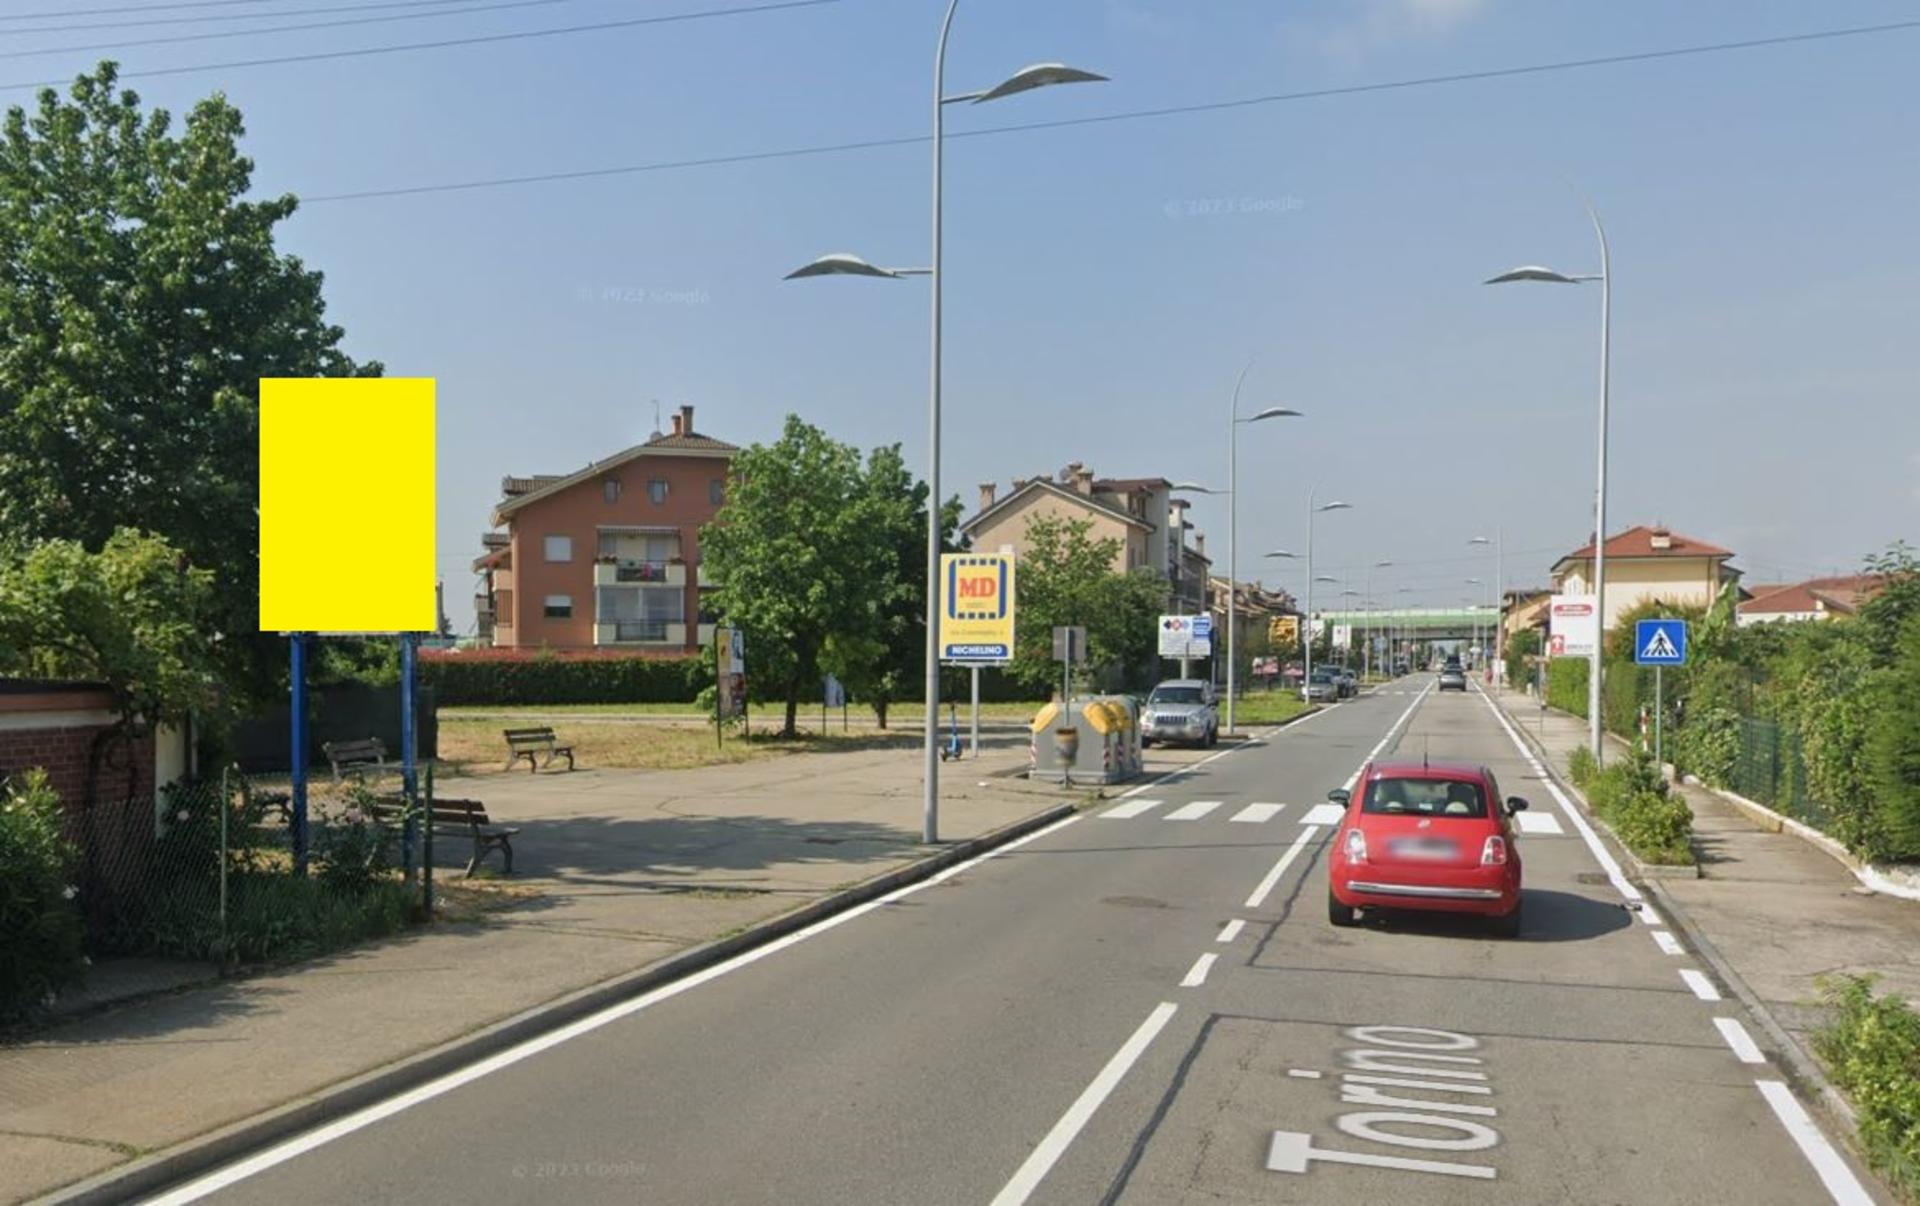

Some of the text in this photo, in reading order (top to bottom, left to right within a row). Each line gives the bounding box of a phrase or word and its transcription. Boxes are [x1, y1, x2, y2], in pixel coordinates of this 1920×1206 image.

[958, 577, 997, 598] MD
[951, 645, 1003, 656] NICHELINO
[1266, 1025, 1499, 1180] Torino
